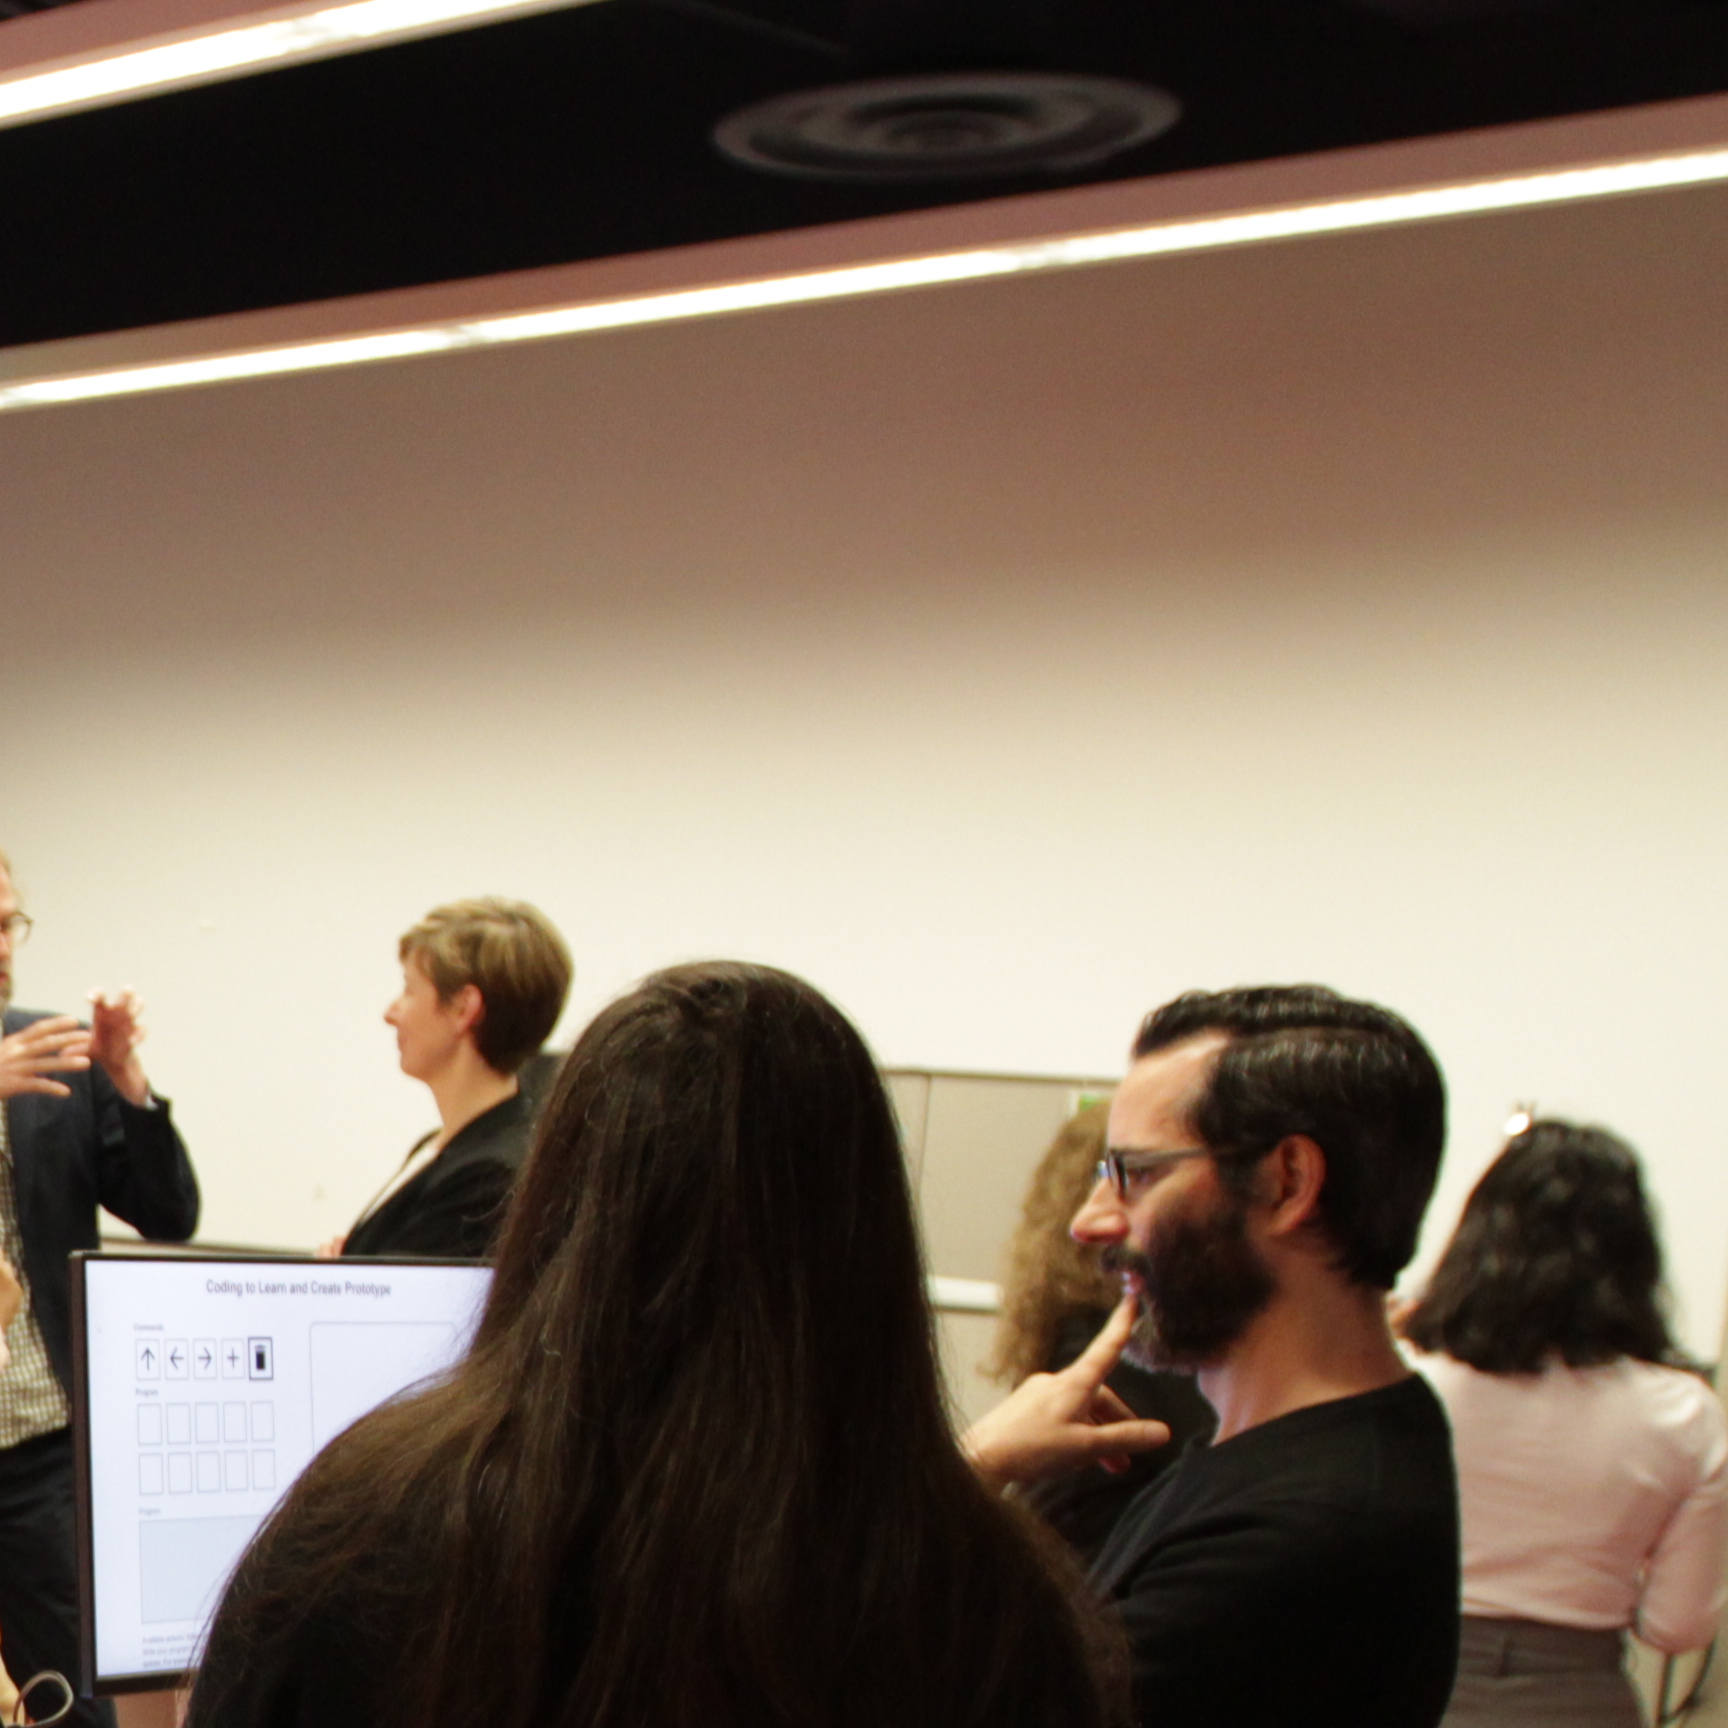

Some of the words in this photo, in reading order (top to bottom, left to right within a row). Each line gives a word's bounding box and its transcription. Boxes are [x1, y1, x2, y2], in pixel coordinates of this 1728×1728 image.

[205, 1278, 243, 1298] Coding
[245, 1280, 256, 1295] to
[258, 1279, 287, 1296] Learn
[289, 1280, 308, 1296] and
[311, 1280, 342, 1296] Create
[345, 1281, 392, 1299] Prototype
